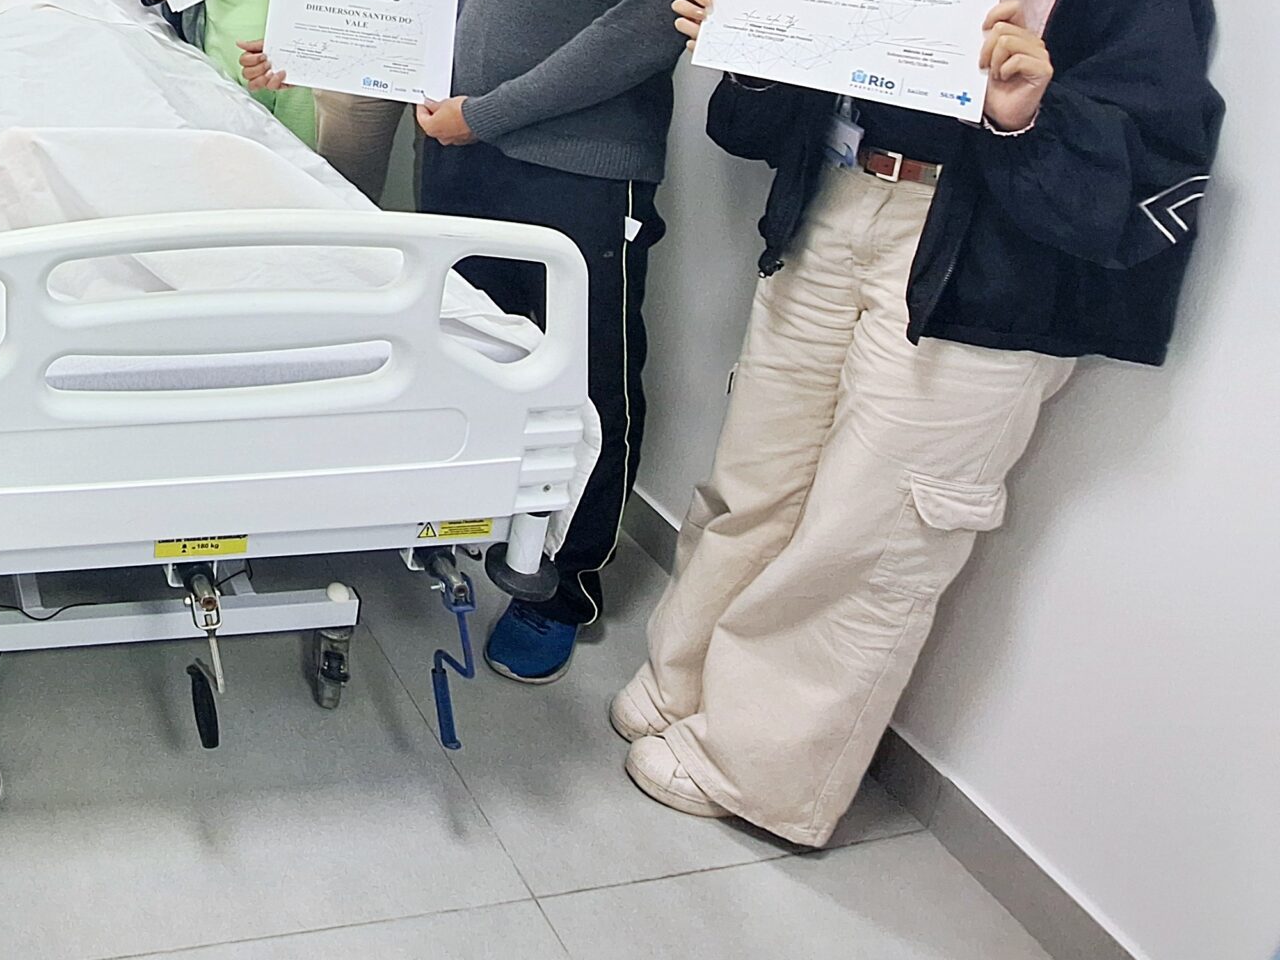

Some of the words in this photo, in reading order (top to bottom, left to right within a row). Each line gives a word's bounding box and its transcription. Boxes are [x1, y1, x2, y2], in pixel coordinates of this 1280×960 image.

[306, 3, 360, 17] DHEMERSON
[362, 11, 397, 22] SANTOS
[399, 15, 413, 24] DO
[346, 19, 369, 28] VALE
[372, 80, 389, 89] Rio
[868, 75, 895, 89] Rio
